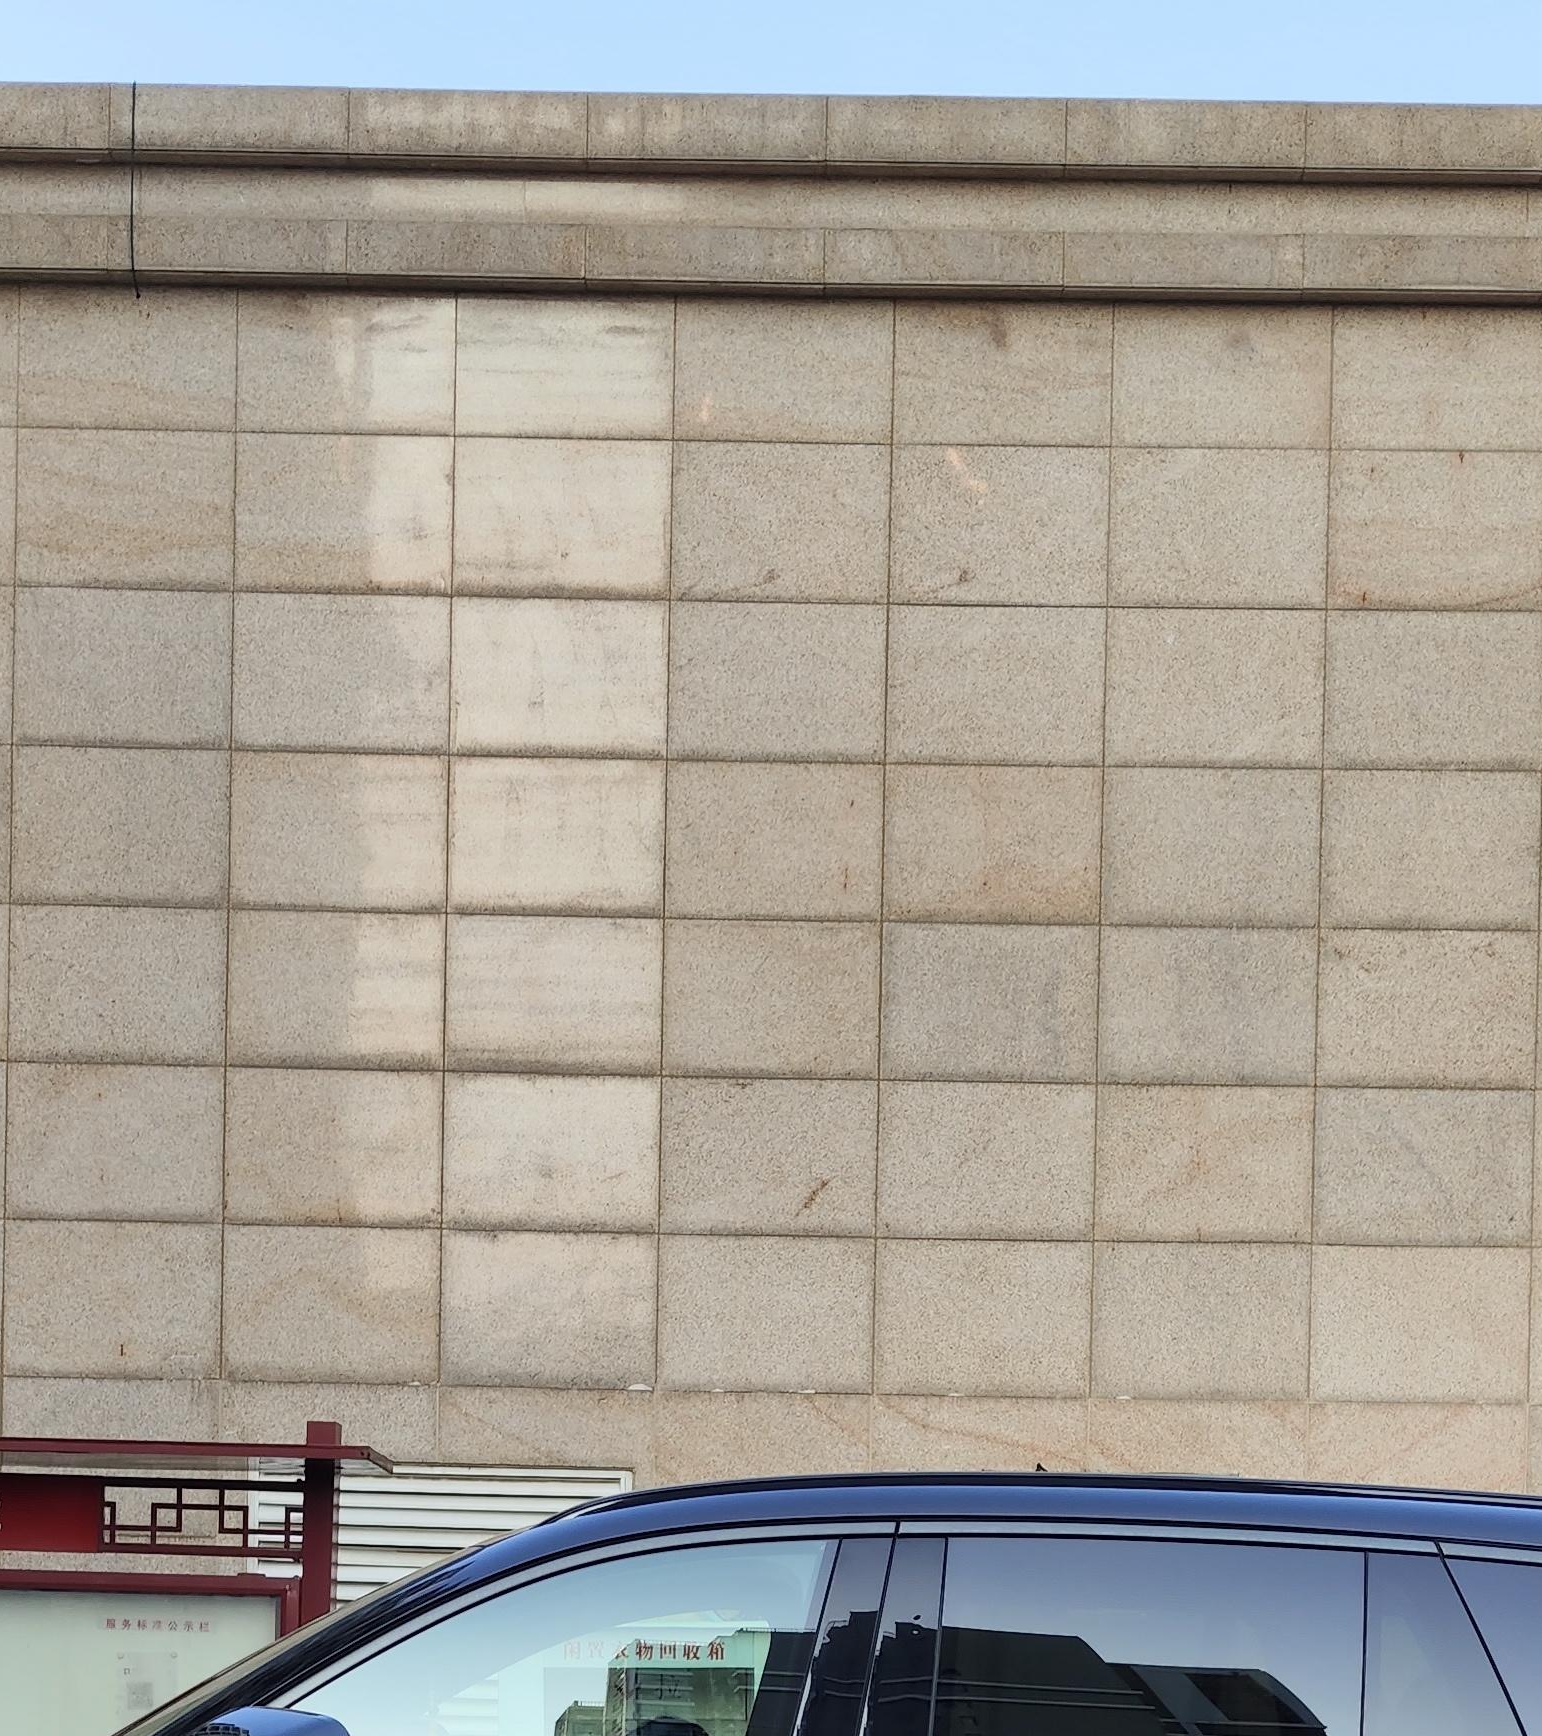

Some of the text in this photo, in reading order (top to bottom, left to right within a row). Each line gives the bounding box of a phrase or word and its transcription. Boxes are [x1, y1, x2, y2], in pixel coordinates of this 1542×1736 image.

[105, 1618, 210, 1633] 服务标准公示栏
